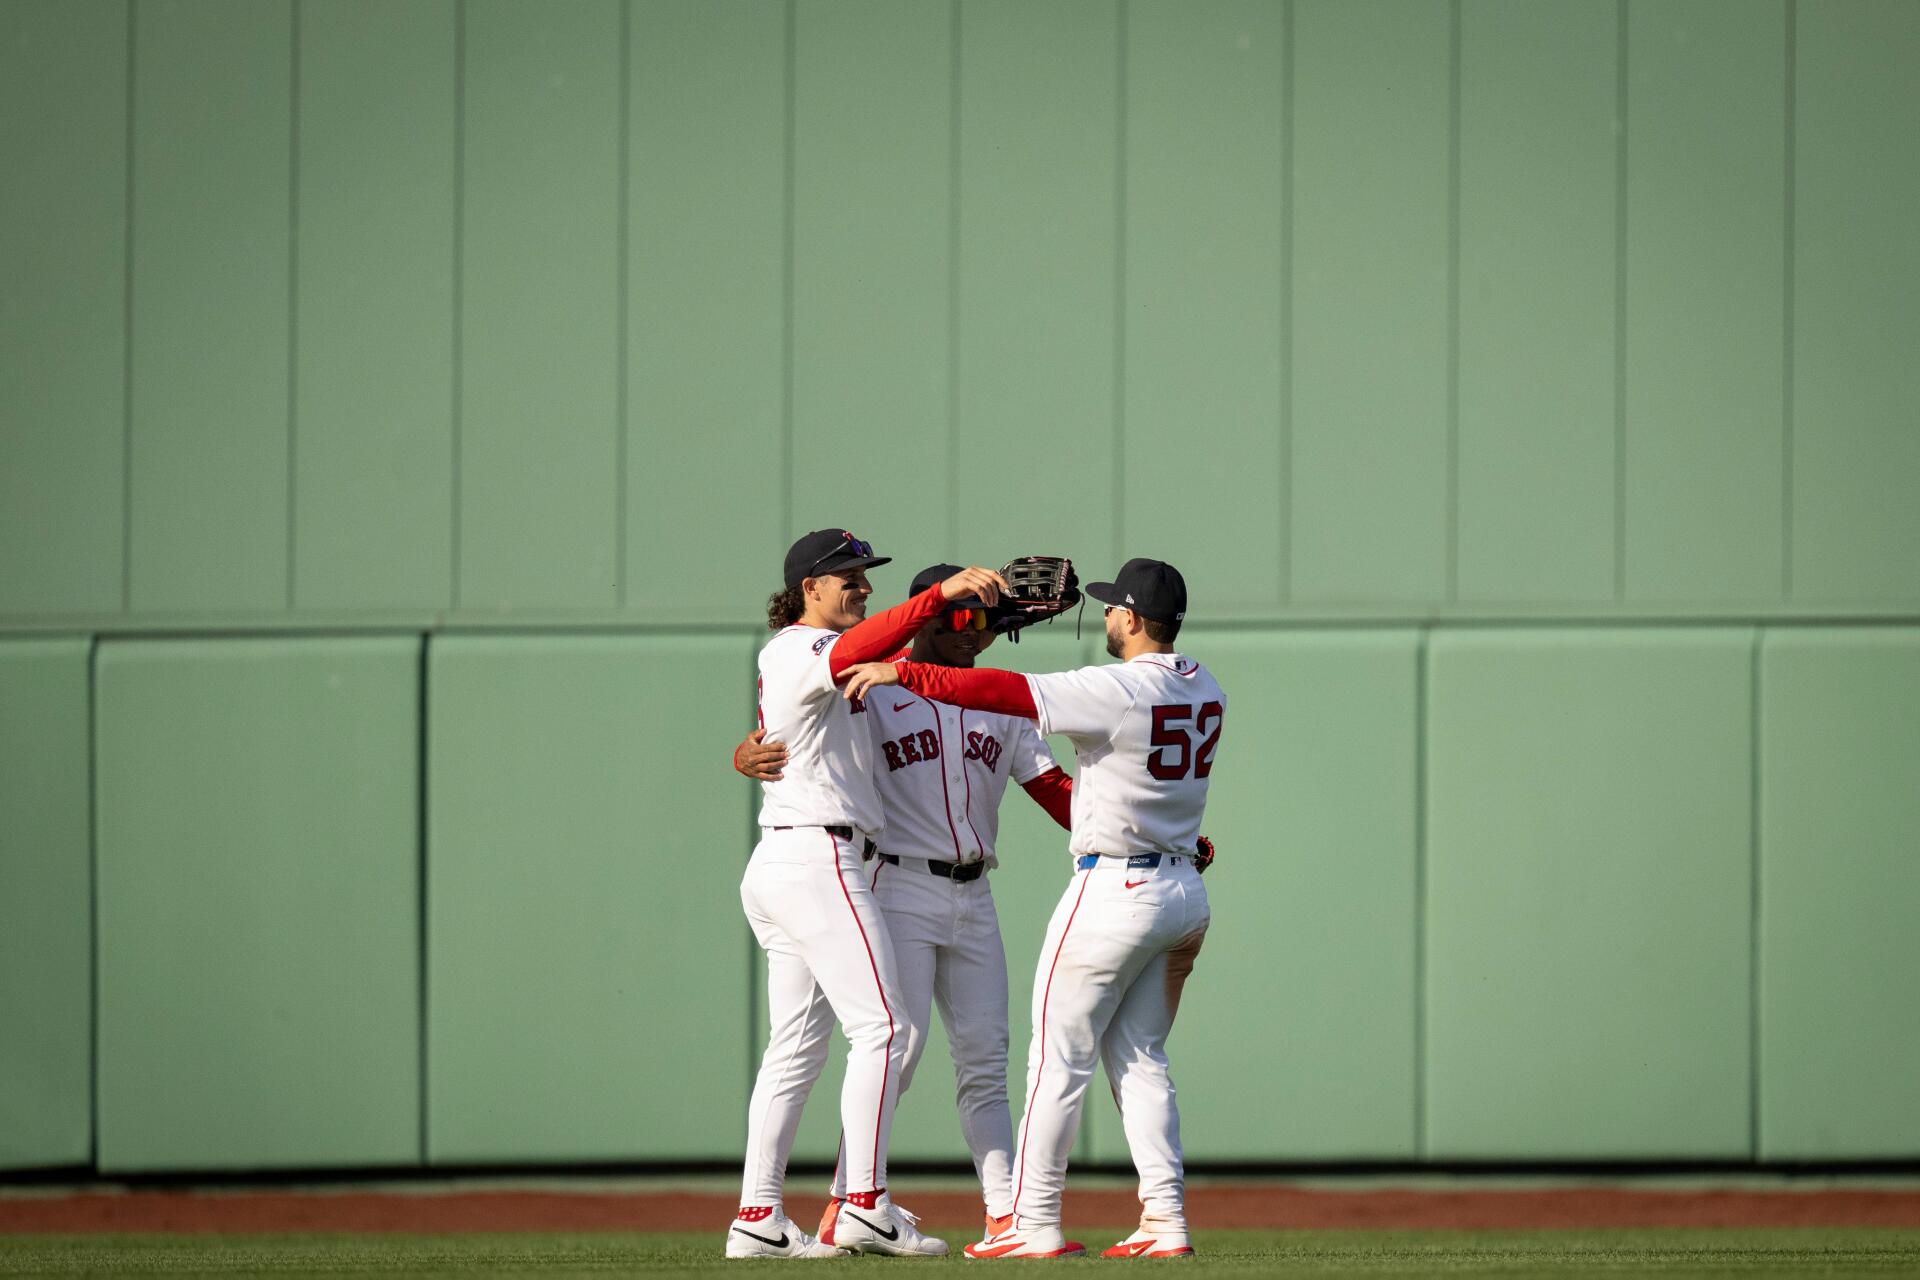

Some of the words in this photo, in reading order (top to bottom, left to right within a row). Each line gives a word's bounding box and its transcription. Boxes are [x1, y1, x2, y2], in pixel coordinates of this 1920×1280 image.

[882, 729, 940, 772] RED
[965, 731, 1003, 774] SOX
[1147, 701, 1223, 780] 52
